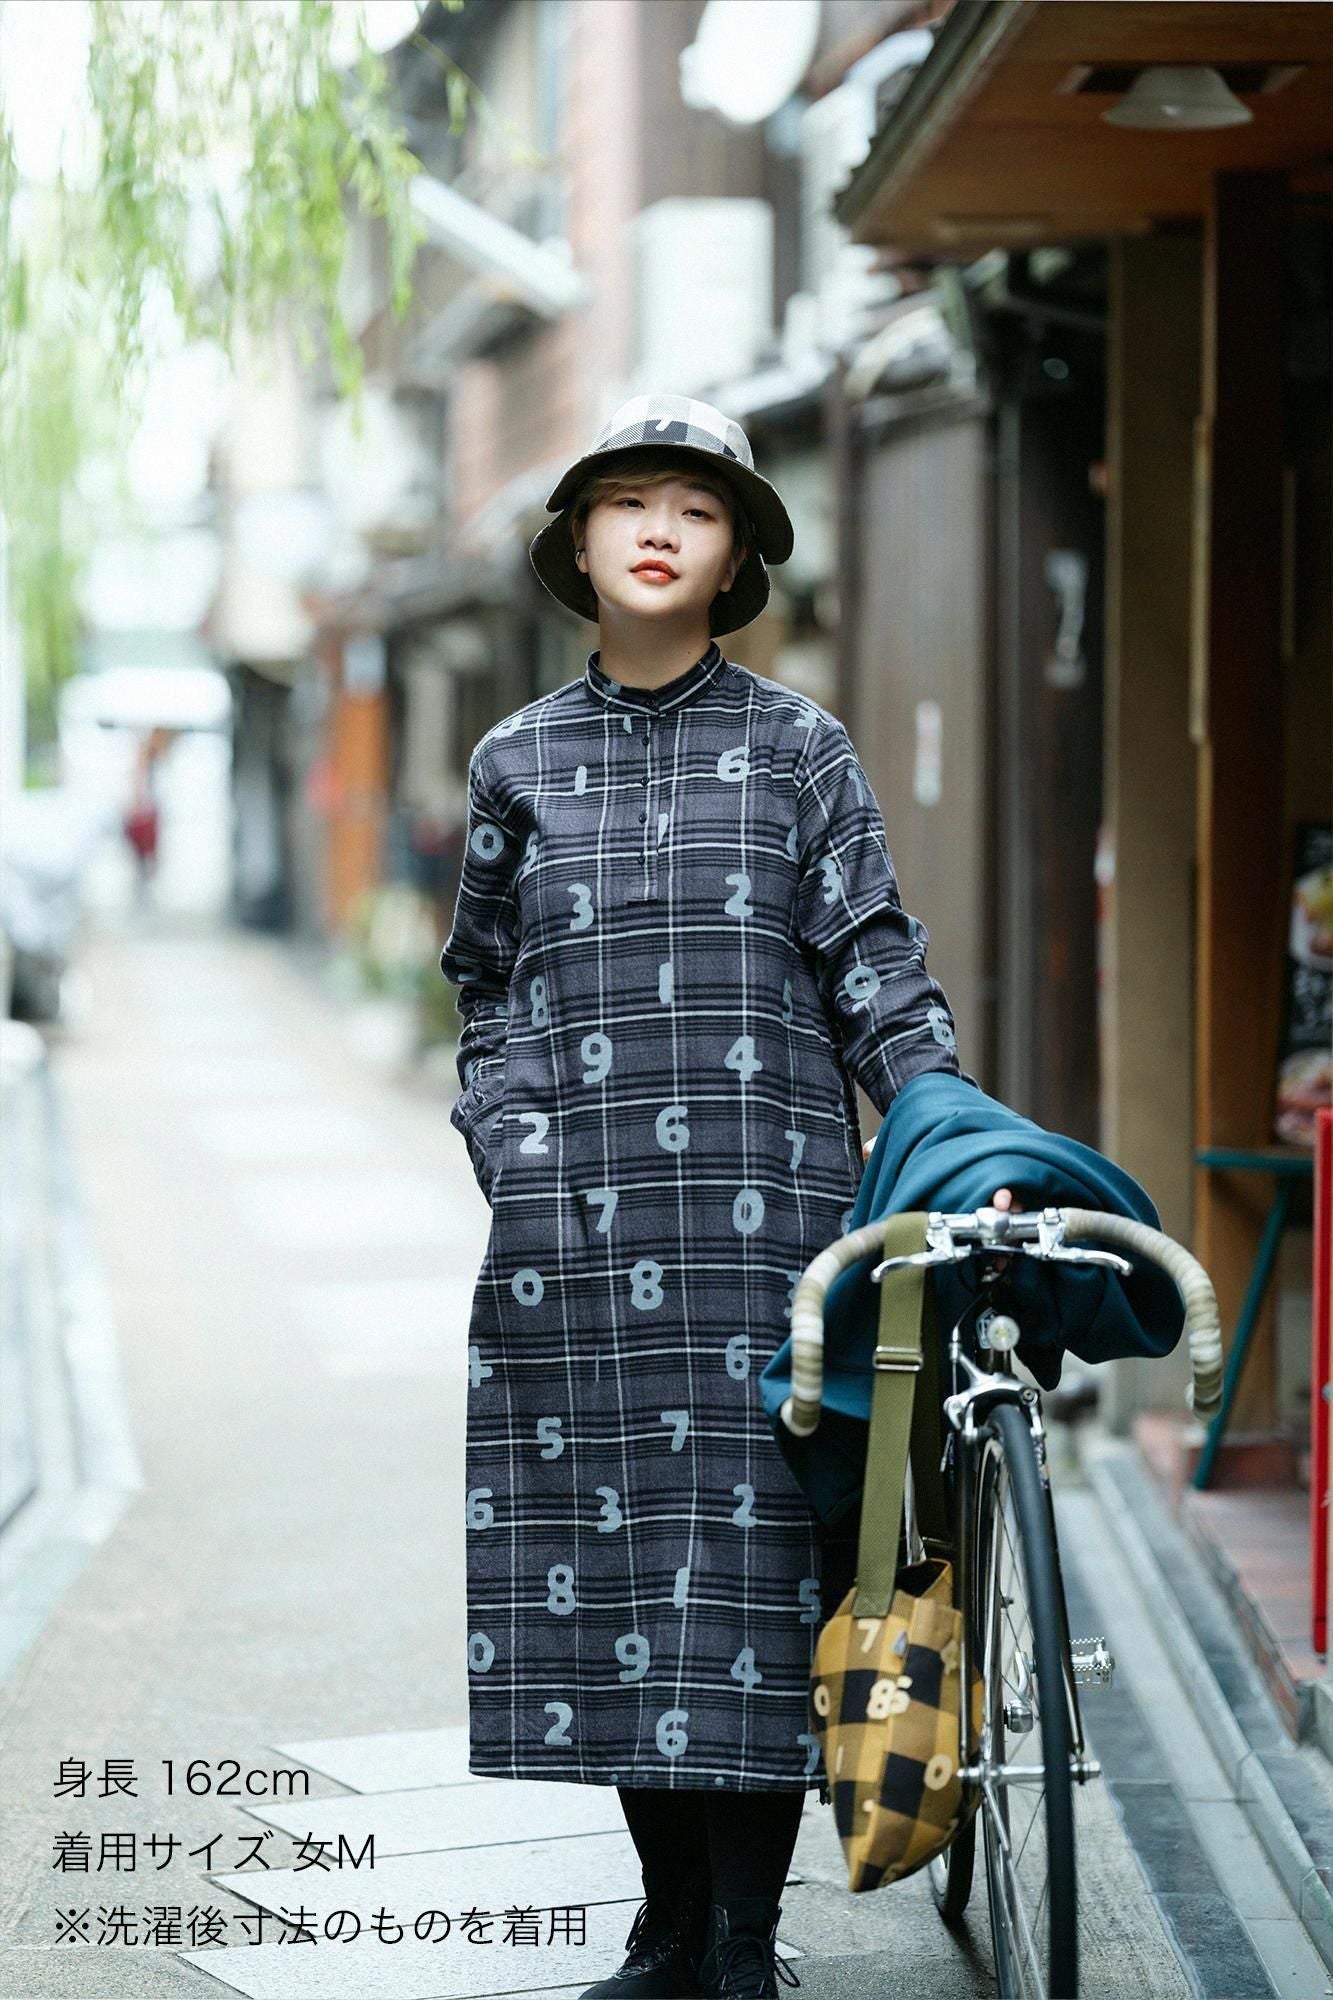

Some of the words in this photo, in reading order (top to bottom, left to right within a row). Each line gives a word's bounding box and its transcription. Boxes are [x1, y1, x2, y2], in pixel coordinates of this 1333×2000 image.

[717, 746, 750, 782] 6
[724, 873, 753, 917] 2
[819, 859, 842, 904] 3
[568, 883, 594, 930] 3
[581, 1033, 613, 1083] 9
[724, 1036, 763, 1081] 4
[518, 1112, 549, 1154] 2
[656, 1106, 690, 1152] 6
[586, 1189, 618, 1233] 7
[630, 1260, 663, 1310] 8
[725, 1334, 751, 1380] 6
[537, 1417, 564, 1459] 5
[660, 1411, 689, 1452] 7
[467, 1488, 494, 1530] 6
[596, 1487, 622, 1533] 3
[732, 1484, 757, 1528] 2
[547, 1564, 576, 1616] 8
[615, 1634, 650, 1682] 9
[857, 1620, 881, 1653] 7
[730, 1648, 762, 1689] 4
[544, 1702, 572, 1746] 2
[656, 1710, 688, 1757] 6
